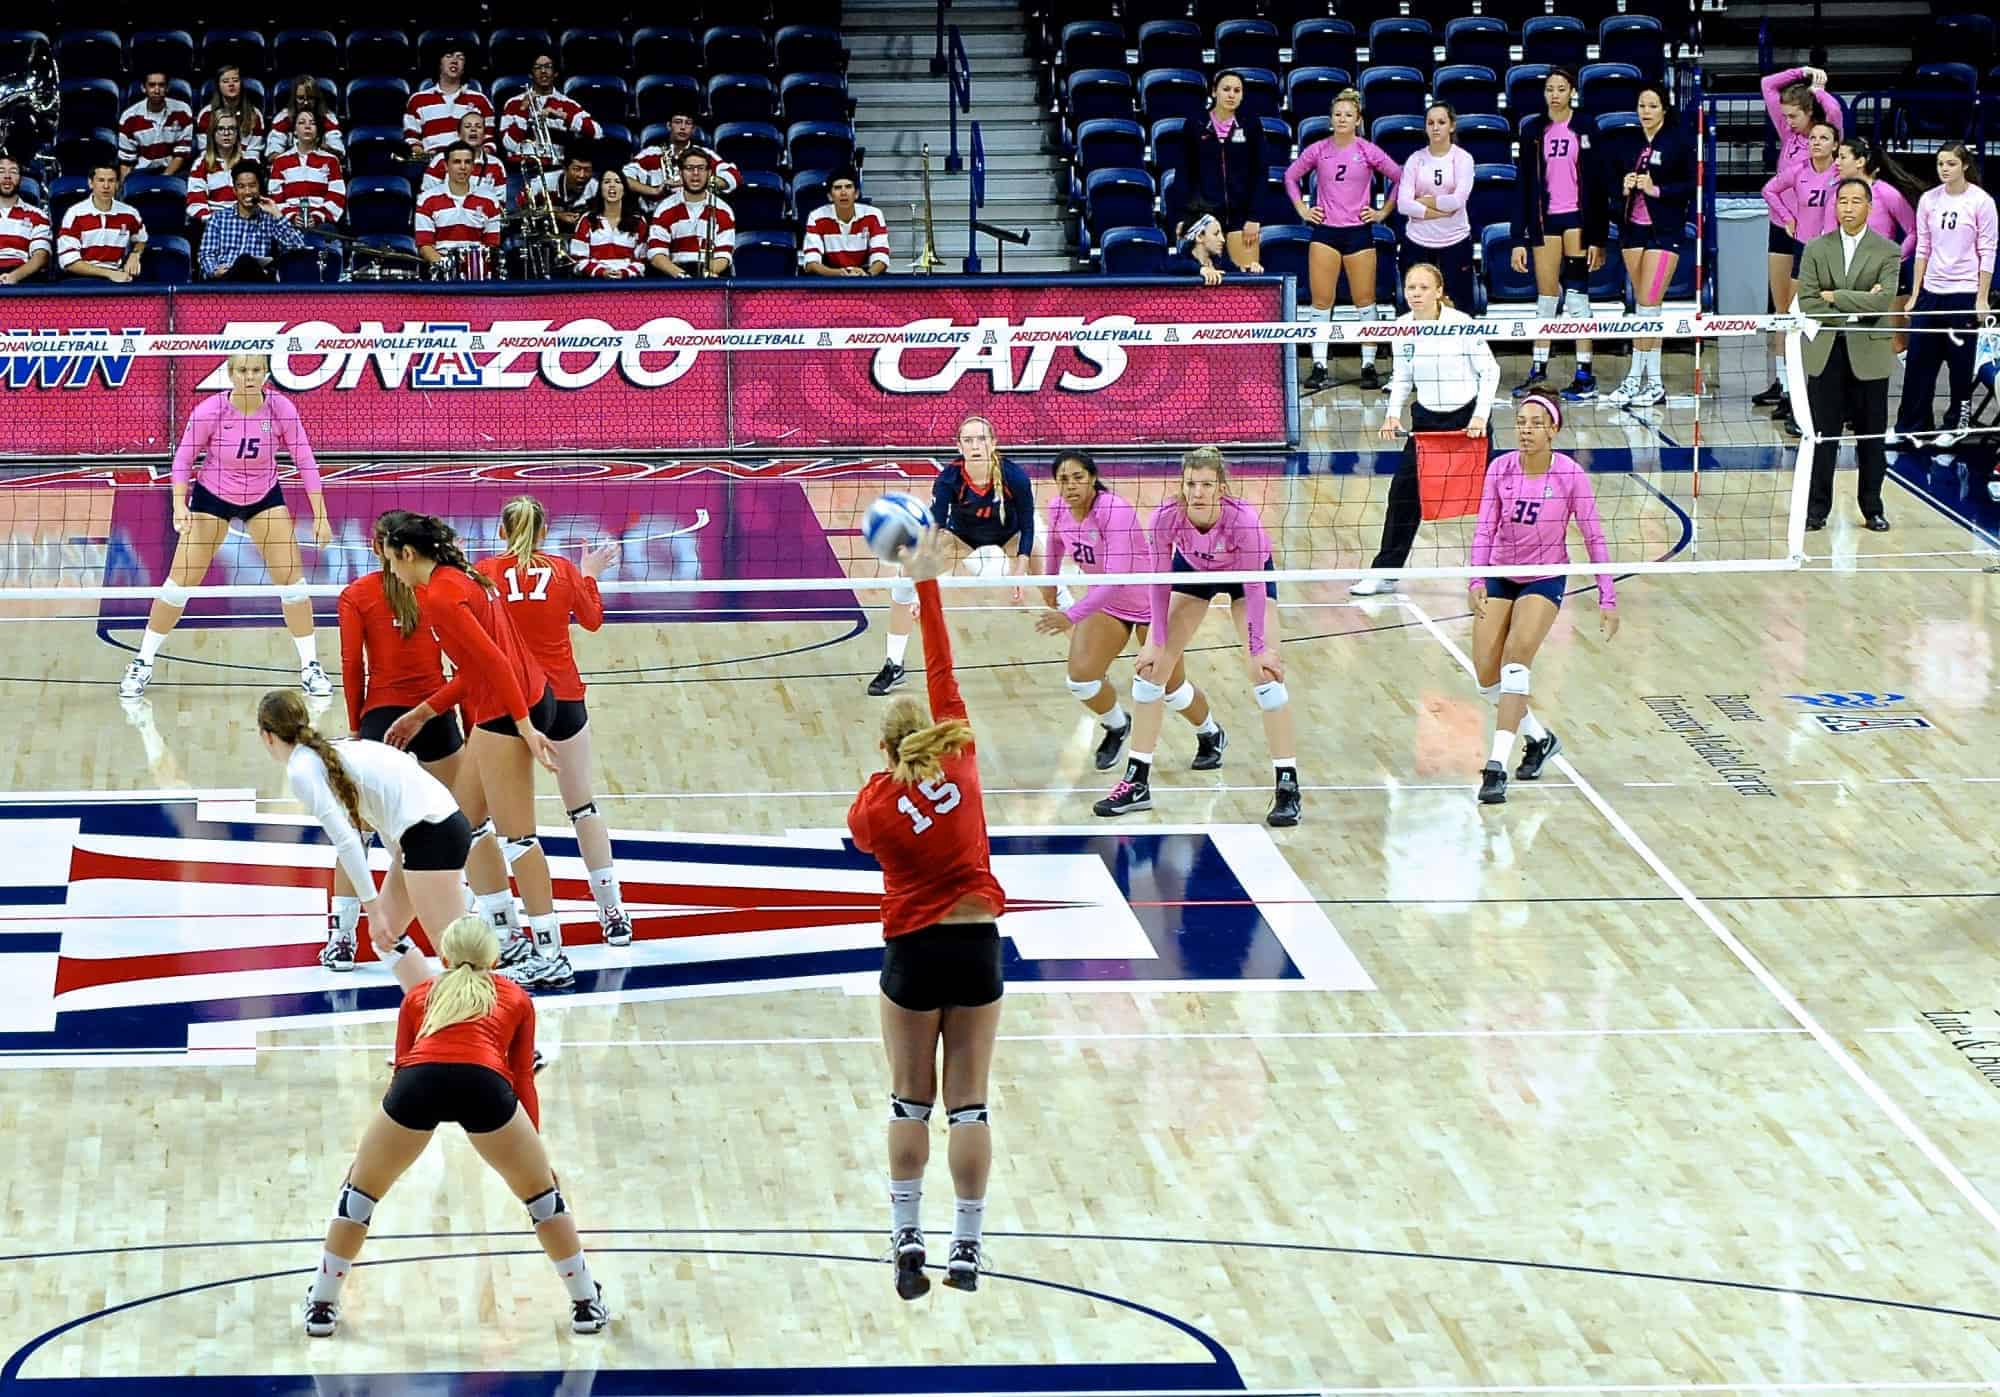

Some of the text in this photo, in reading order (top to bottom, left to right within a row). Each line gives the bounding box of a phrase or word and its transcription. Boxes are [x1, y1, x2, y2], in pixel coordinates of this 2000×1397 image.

[1549, 139, 1569, 157] 33
[1335, 164, 1347, 181] 2
[1434, 169, 1442, 186] 5
[1808, 189, 1826, 207] 21
[1941, 211, 1958, 230] 13
[873, 315, 1128, 392] CATS
[236, 438, 261, 459] 15
[1511, 500, 1541, 525] 35
[1072, 542, 1096, 565] 20
[504, 567, 553, 602] 17
[897, 782, 961, 835] 15
